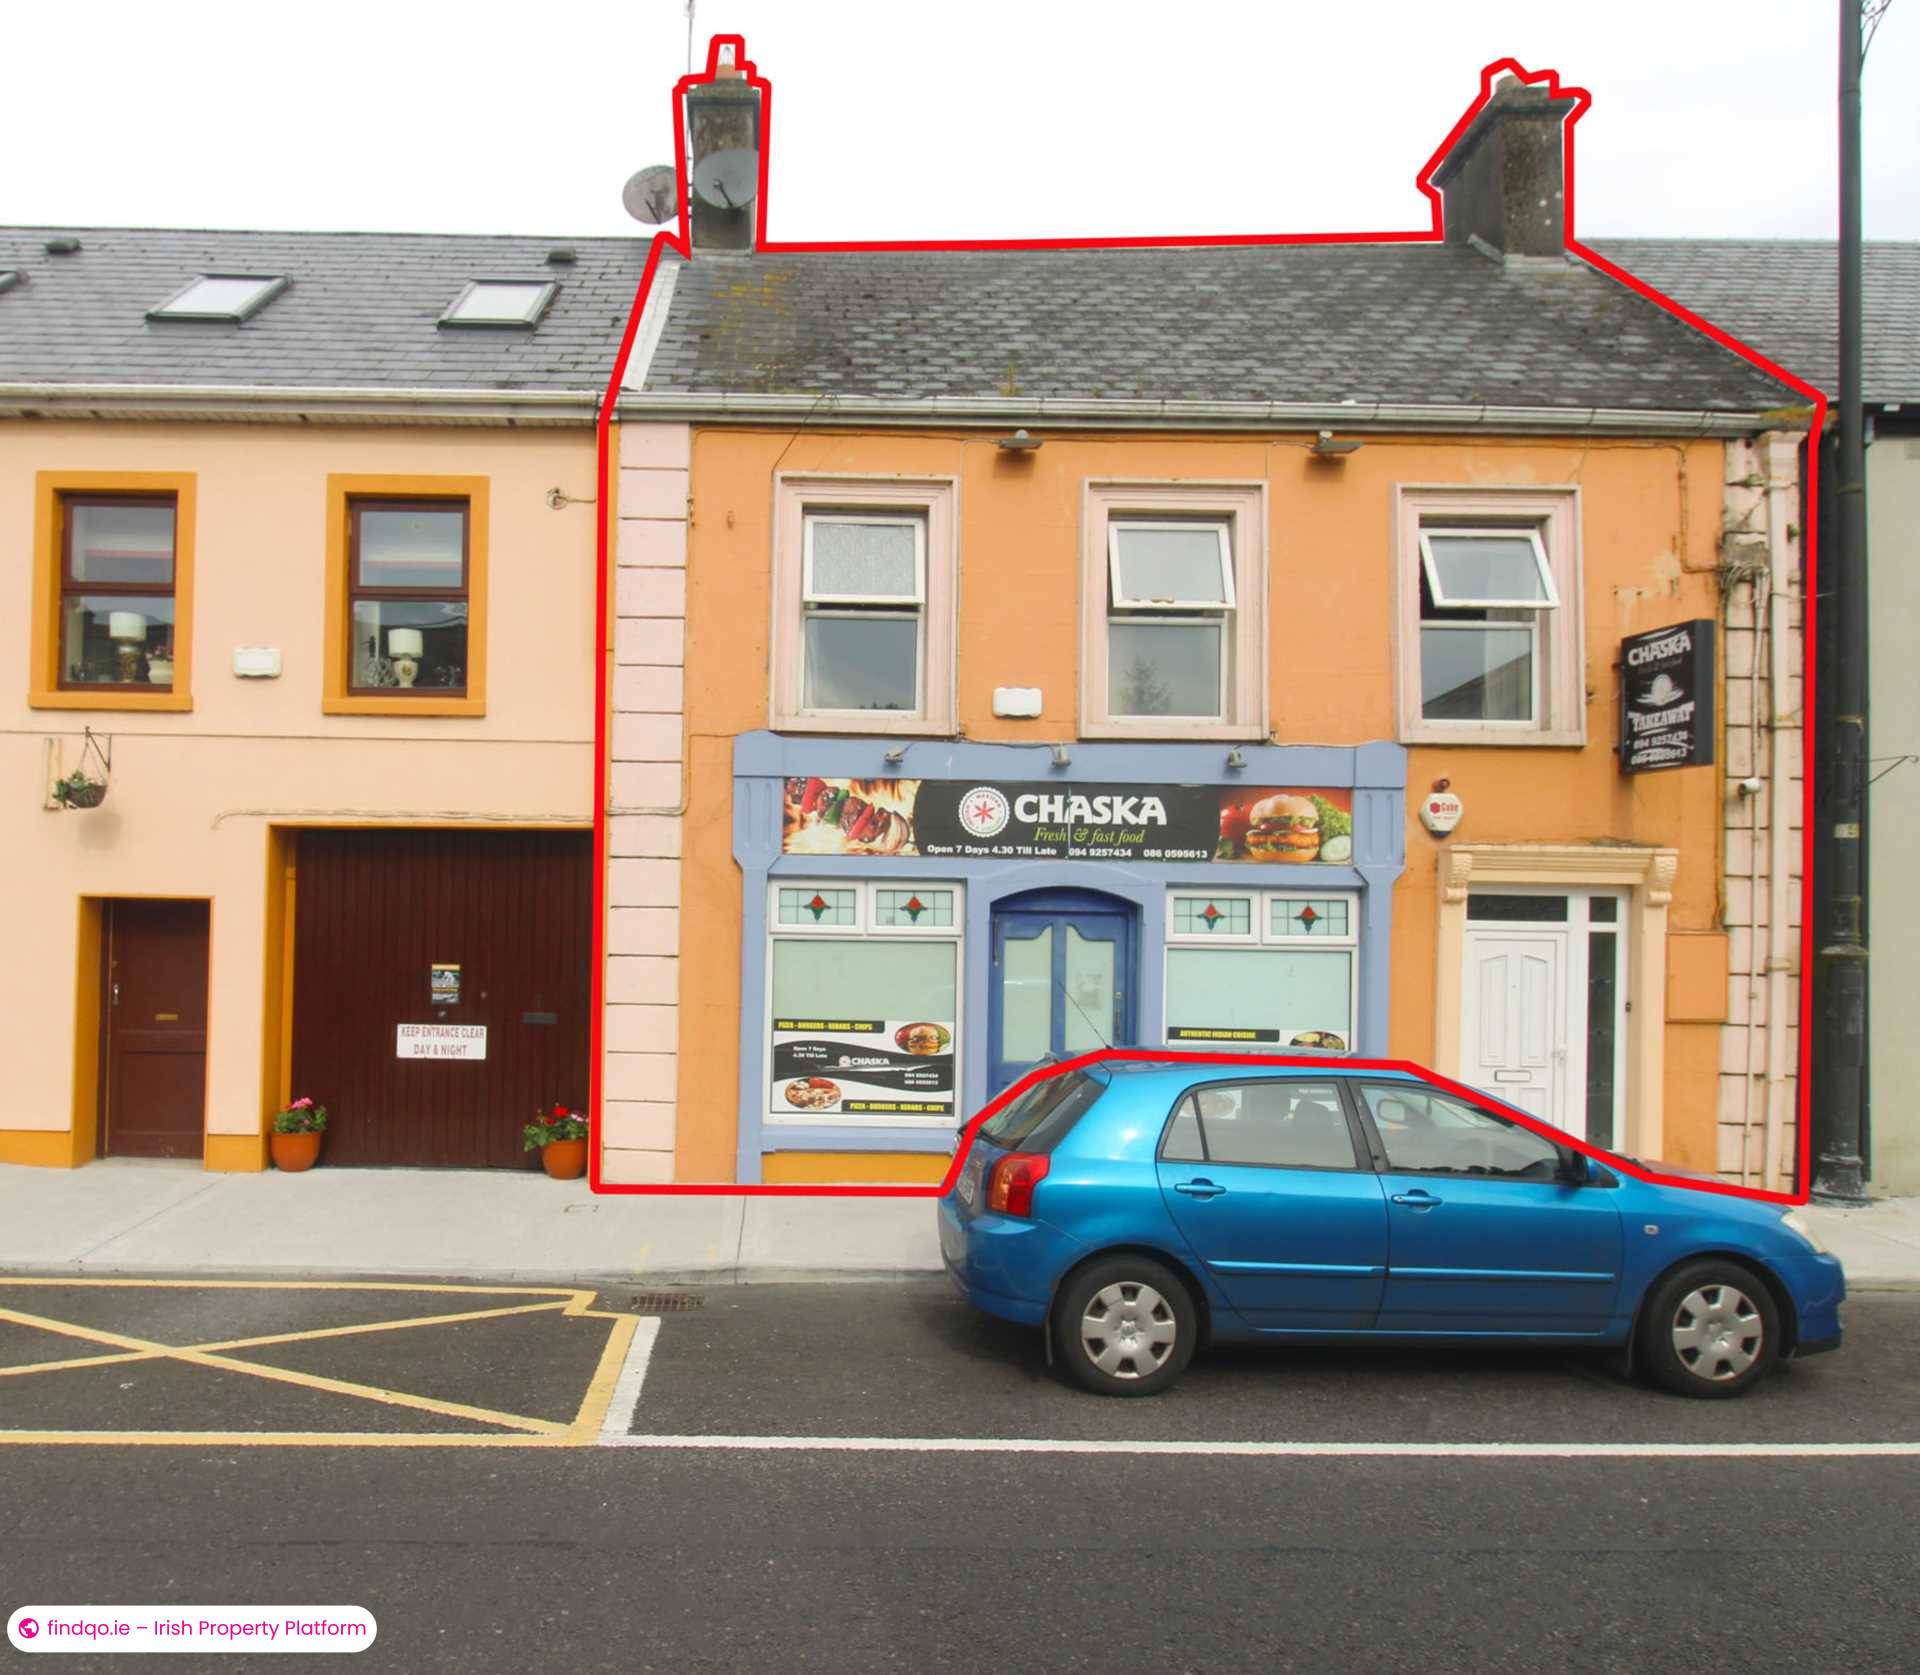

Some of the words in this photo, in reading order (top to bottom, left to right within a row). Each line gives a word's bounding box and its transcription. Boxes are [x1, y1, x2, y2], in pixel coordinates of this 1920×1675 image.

[1628, 630, 1691, 666] CHASKA
[1628, 701, 1695, 732] TAKEAWAY
[1014, 794, 1167, 825] CHASKA
[1034, 827, 1067, 841] Fresh
[1073, 828, 1088, 841] &
[1088, 830, 1115, 846] fast
[1114, 829, 1145, 846] food
[927, 845, 953, 854] Open
[955, 845, 962, 853] 7
[965, 845, 989, 855] Days
[991, 846, 1013, 854] 4.30
[1016, 846, 1032, 855] Till
[1035, 847, 1057, 855] Late
[1068, 848, 1087, 856] 094
[401, 1026, 420, 1037] KEEP
[422, 1026, 460, 1038] ENTRANCE
[462, 1028, 484, 1038] CLEAR
[414, 1044, 431, 1055] DAY
[440, 1045, 467, 1056] NIGHT
[851, 1057, 890, 1065] CHASKA
